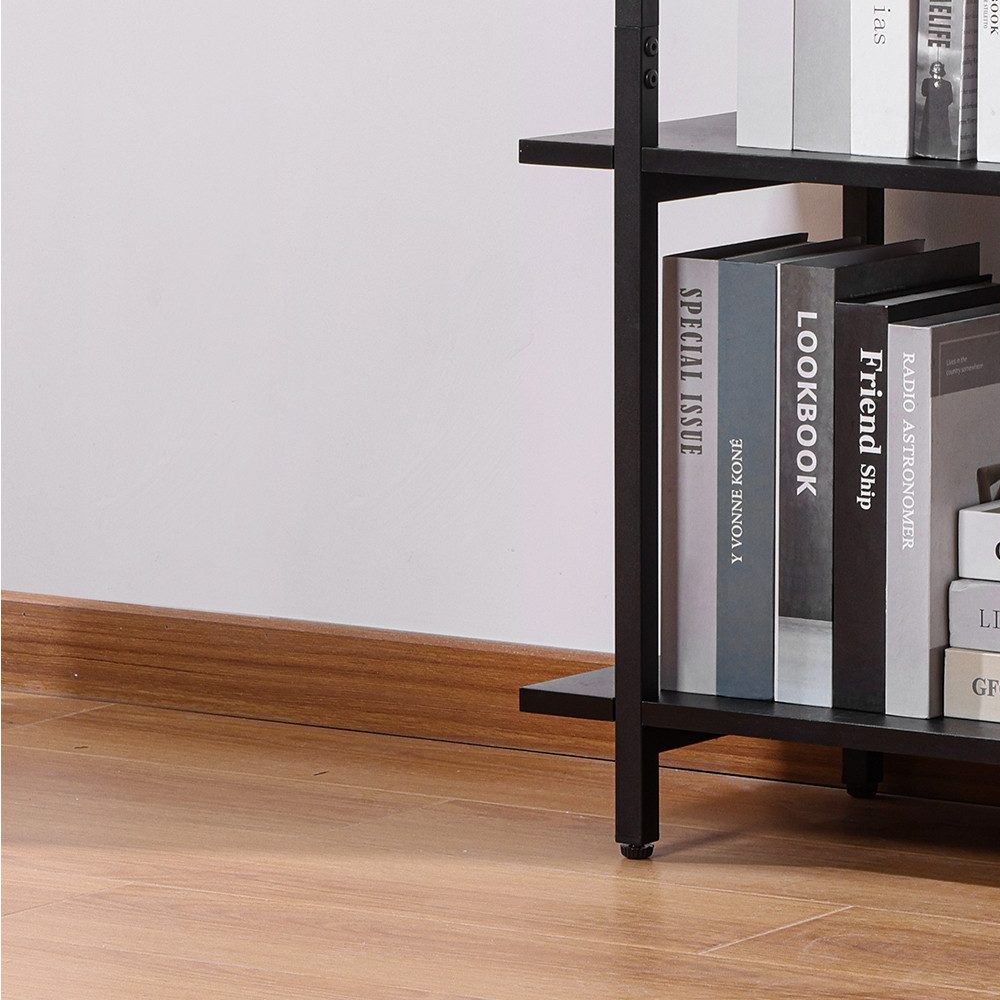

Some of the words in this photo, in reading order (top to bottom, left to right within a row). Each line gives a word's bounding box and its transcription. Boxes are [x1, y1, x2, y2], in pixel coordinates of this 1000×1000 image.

[679, 287, 702, 382] SPECIAL
[796, 310, 818, 497] LOOKBOOK
[858, 347, 883, 455] Friend
[901, 351, 916, 413] RADIO
[679, 392, 703, 457] ISSUE
[729, 438, 743, 486] KONÉ
[856, 464, 876, 511] Ship
[901, 420, 916, 550] ASTRONOMER
[731, 489, 743, 549] VONNE
[731, 553, 743, 564] Y
